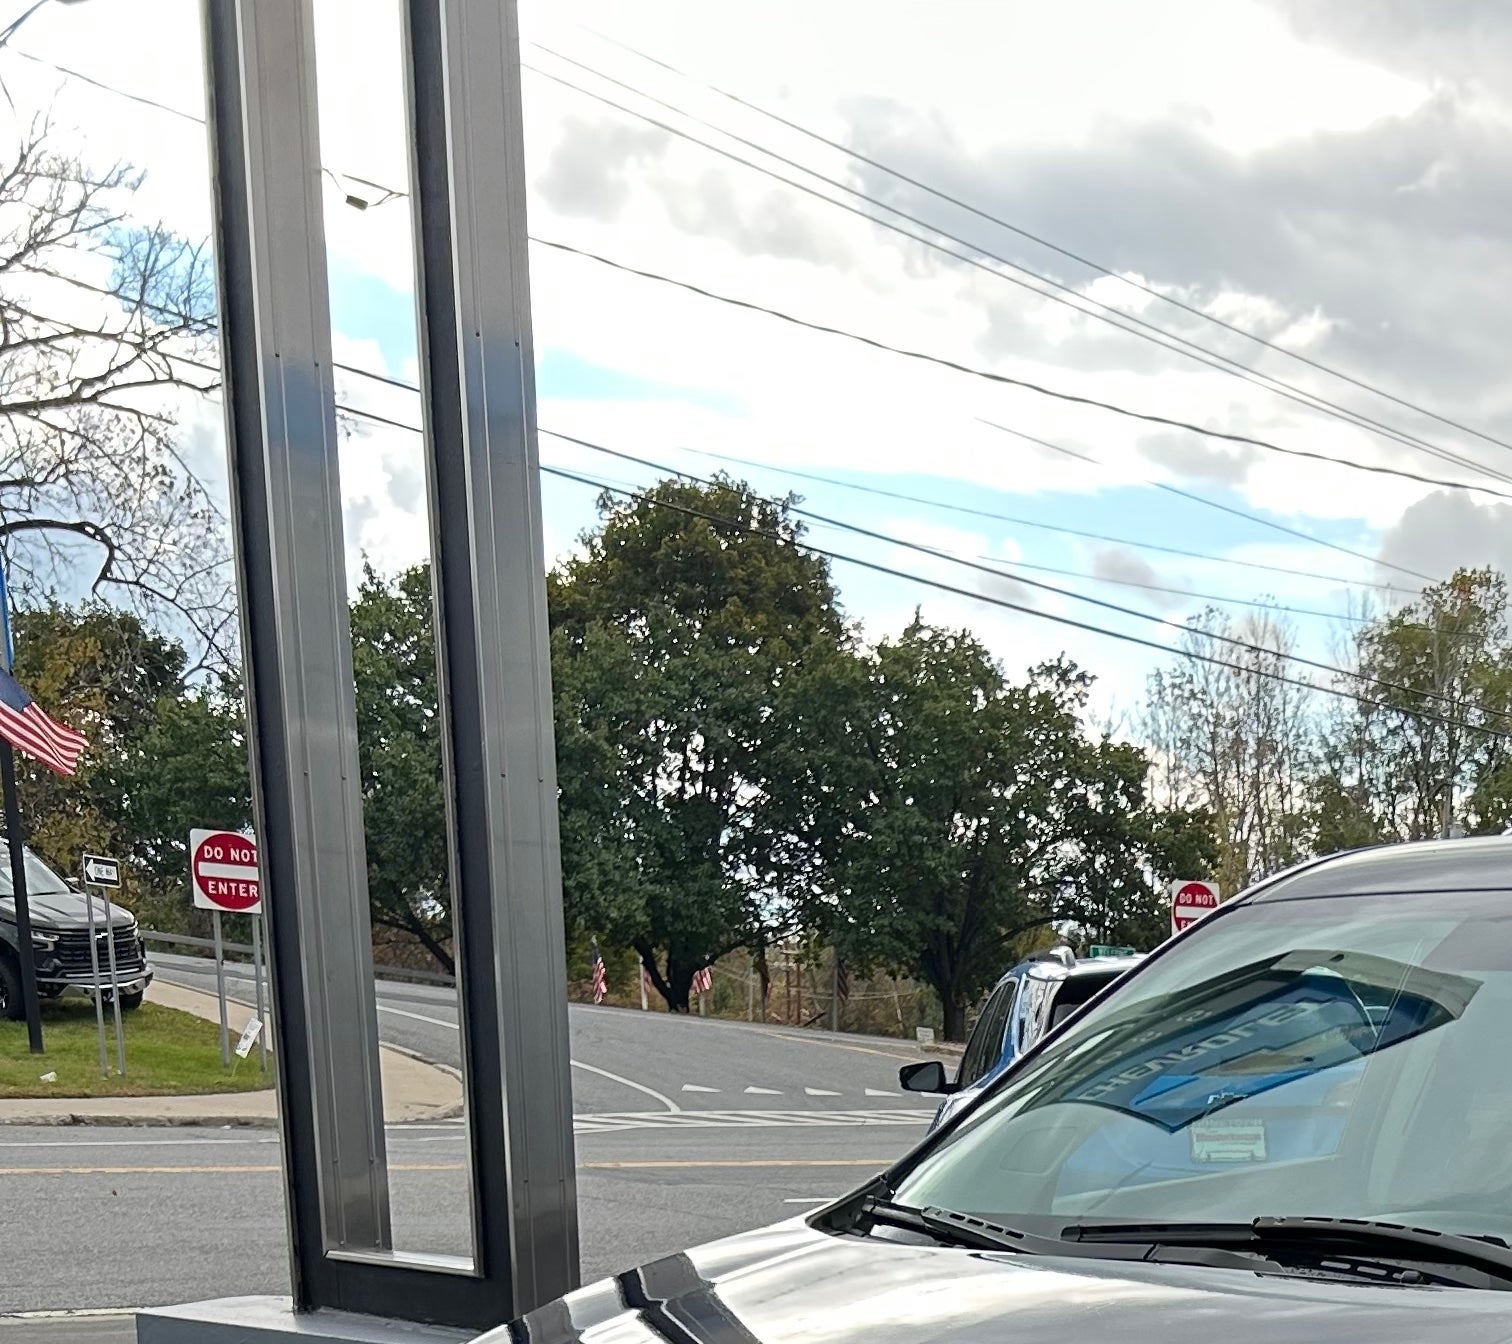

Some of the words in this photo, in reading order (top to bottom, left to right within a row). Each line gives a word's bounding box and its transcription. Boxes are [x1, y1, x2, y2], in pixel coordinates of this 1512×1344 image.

[203, 845, 224, 860] DO
[230, 848, 258, 864] NOT
[208, 880, 259, 899] ENTER
[1179, 892, 1192, 904] DO
[1195, 893, 1214, 905] NOT
